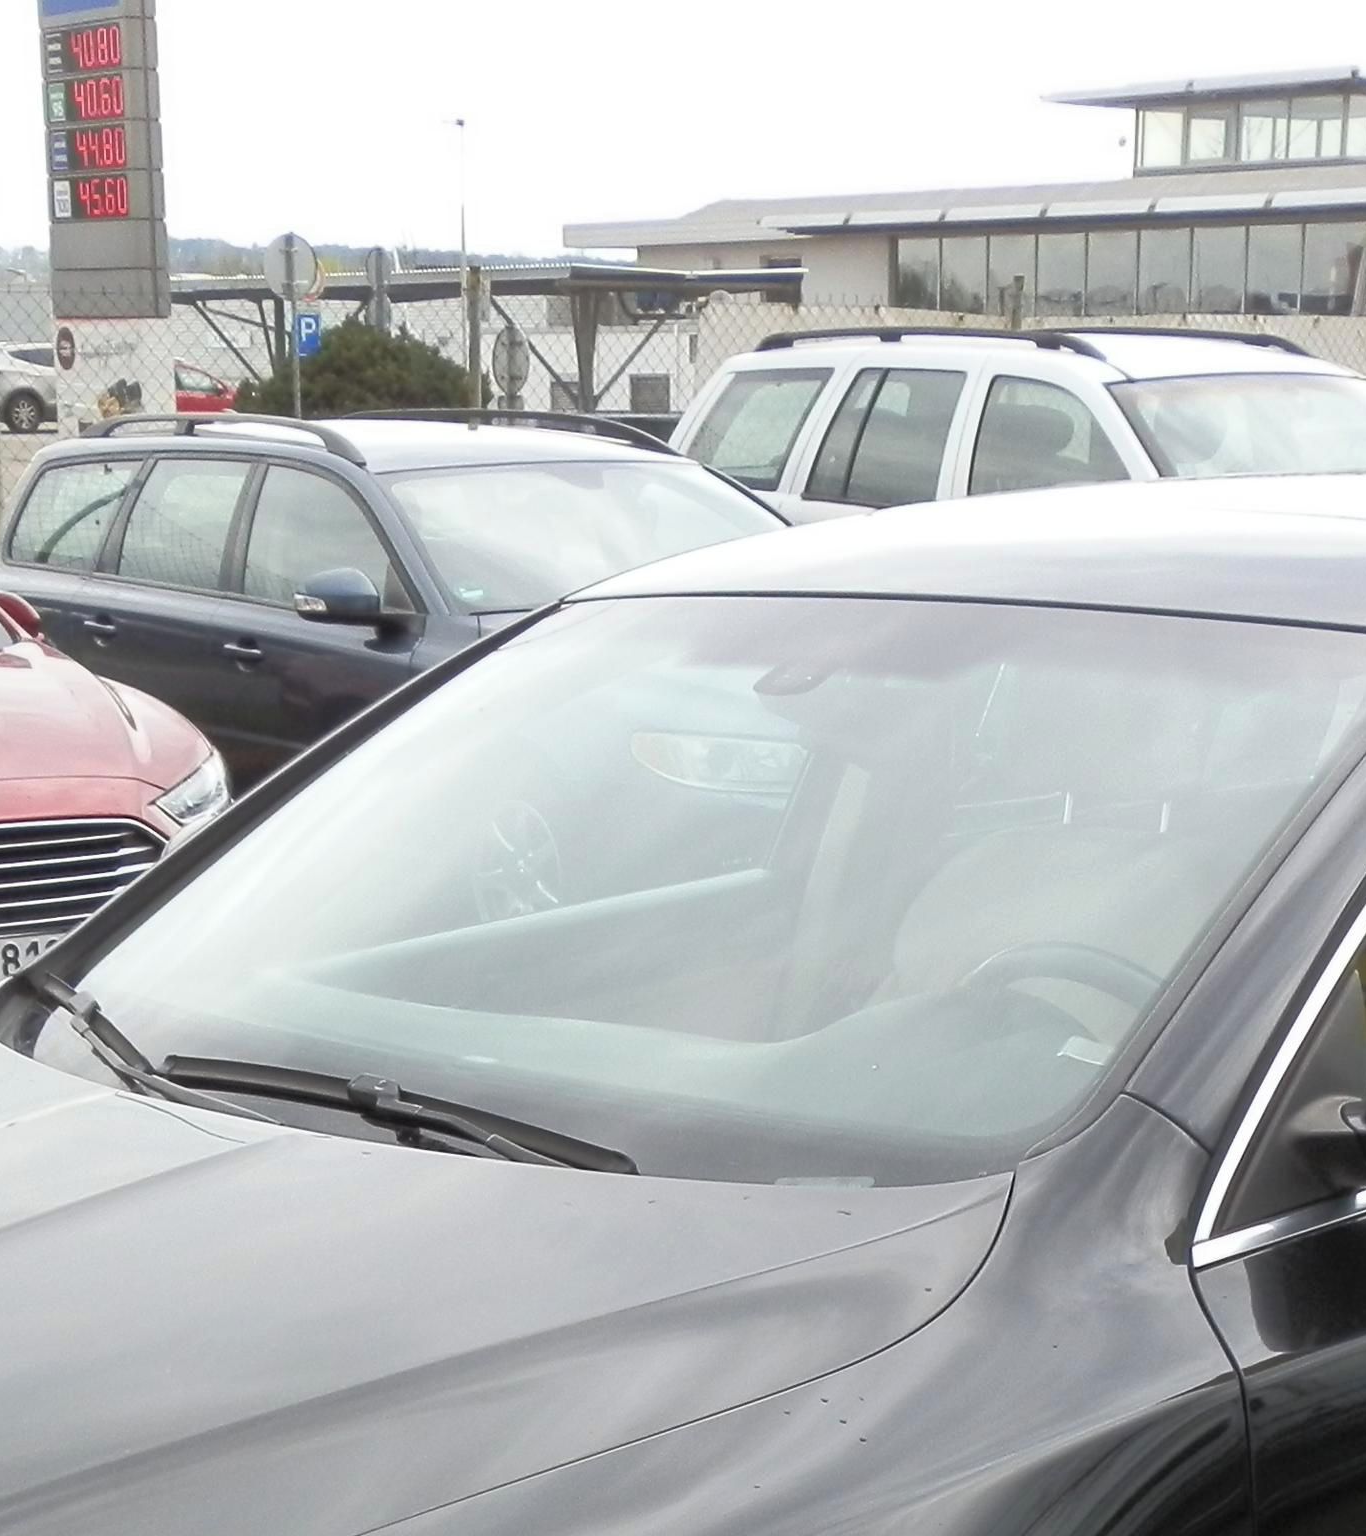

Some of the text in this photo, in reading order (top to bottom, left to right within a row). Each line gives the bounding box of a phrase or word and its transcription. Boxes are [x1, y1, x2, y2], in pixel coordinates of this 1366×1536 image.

[76, 128, 125, 166] 44.80
[80, 177, 127, 215] 45.60
[300, 317, 316, 341] P
[1, 939, 60, 977] 81
